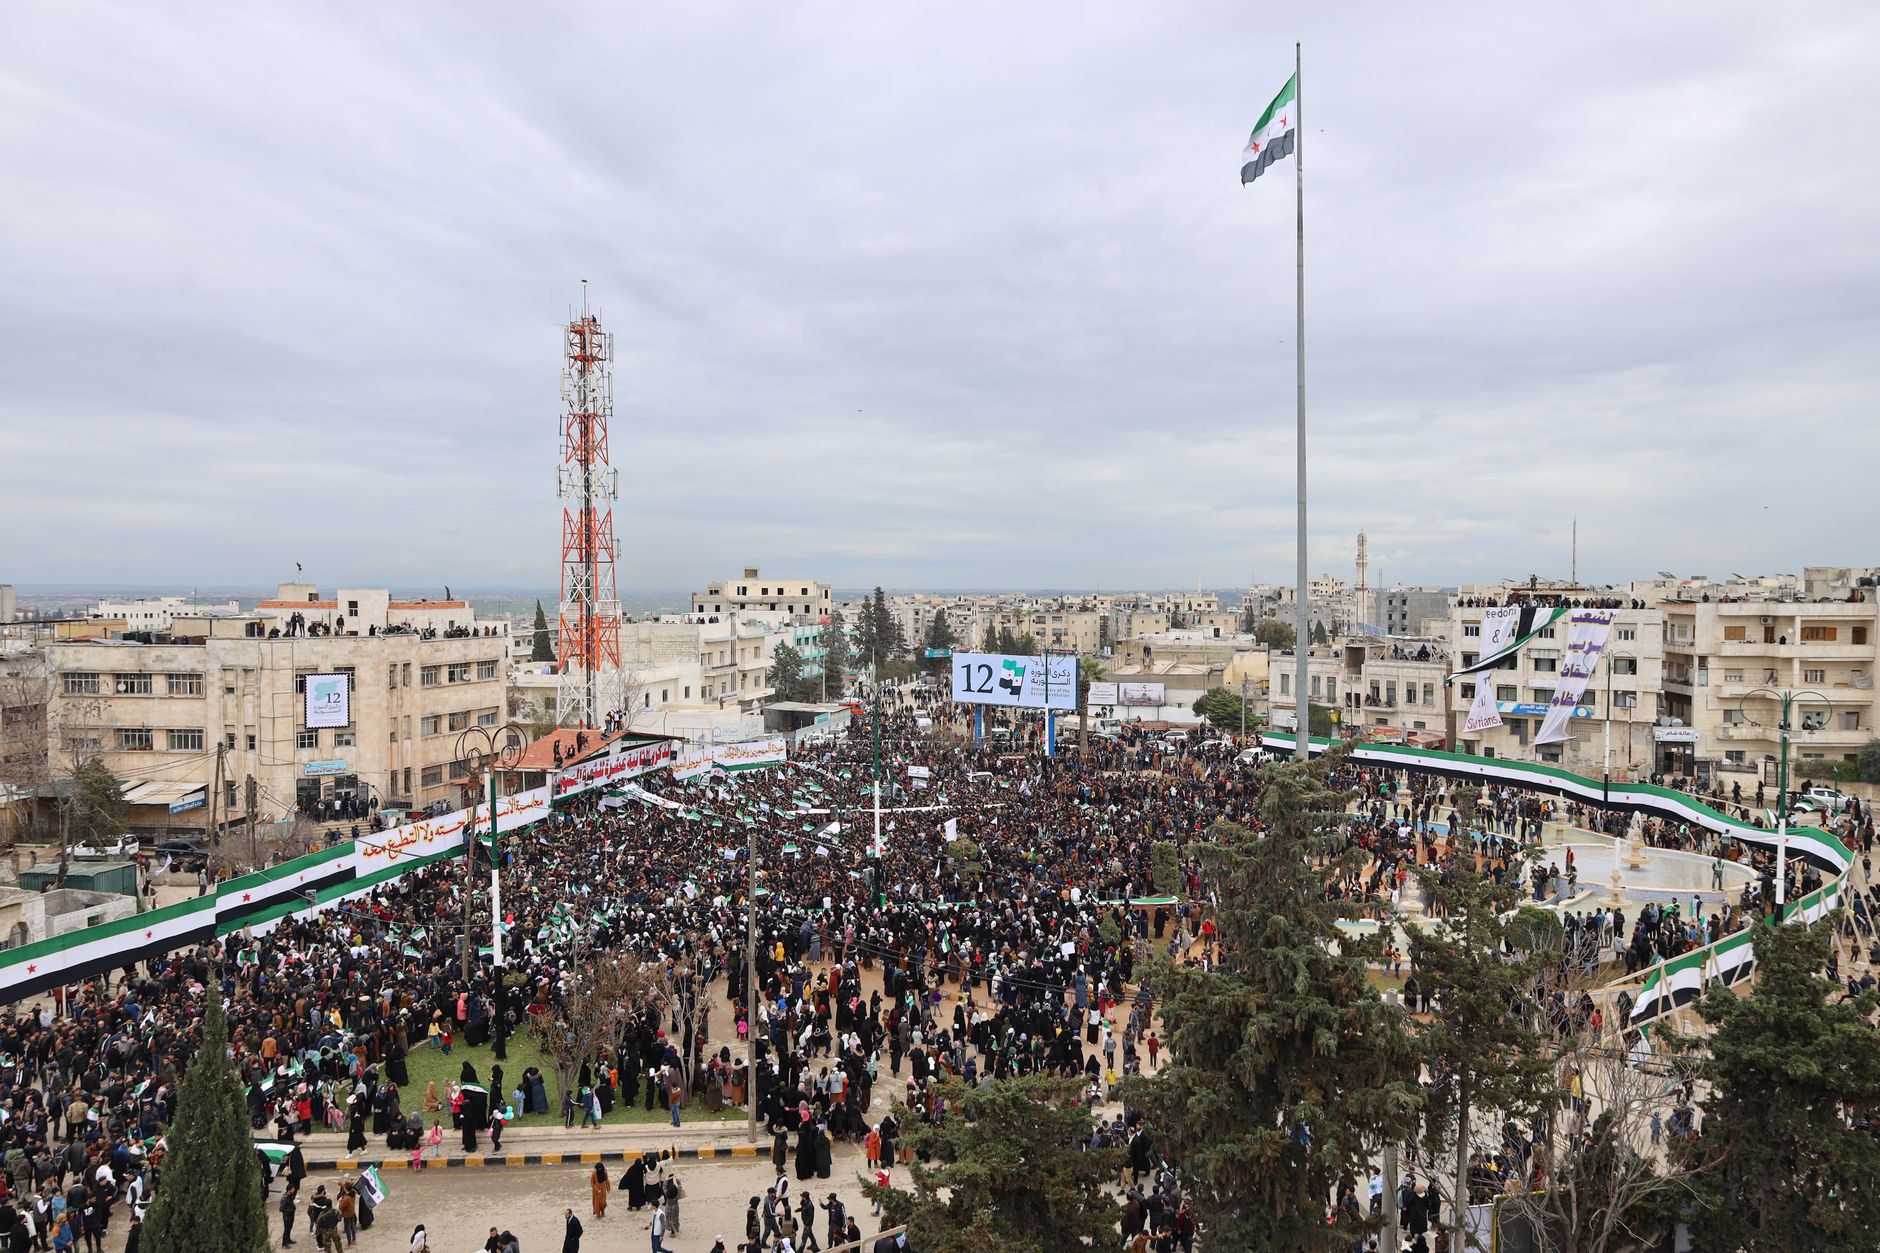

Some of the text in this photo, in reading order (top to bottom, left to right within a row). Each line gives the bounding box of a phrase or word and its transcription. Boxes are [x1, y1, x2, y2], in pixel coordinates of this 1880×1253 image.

[1486, 608, 1517, 618] eedom
[1492, 629, 1501, 644] &
[961, 664, 994, 694] 12
[325, 692, 341, 704] 12
